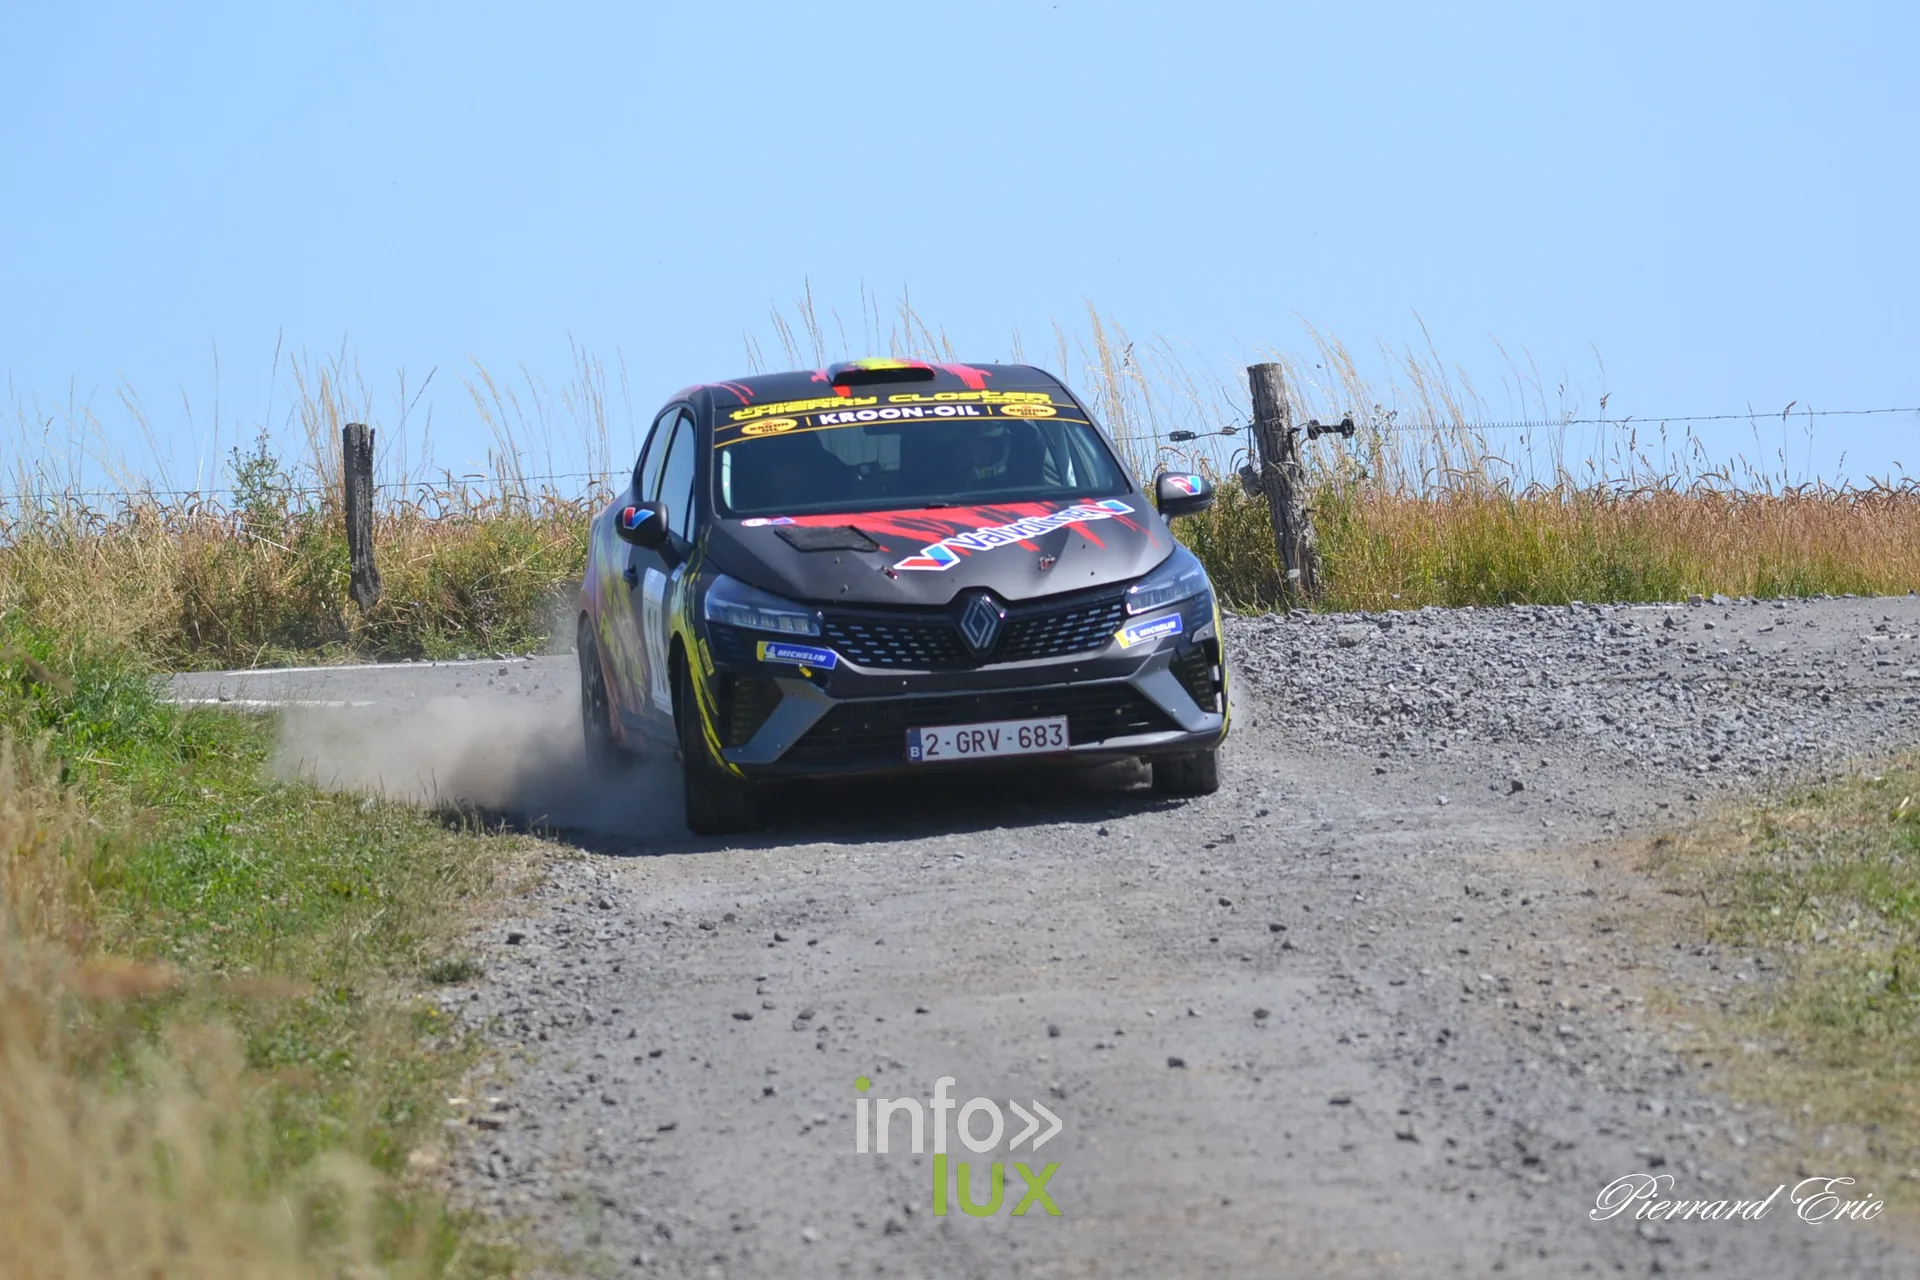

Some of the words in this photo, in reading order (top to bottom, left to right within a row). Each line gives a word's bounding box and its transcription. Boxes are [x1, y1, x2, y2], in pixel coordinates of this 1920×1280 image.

[819, 405, 980, 424] KROON-OIL
[947, 506, 1092, 549] Valvoline
[1139, 621, 1176, 637] MICHELIN
[777, 649, 827, 662] MICHELIN
[910, 747, 920, 757] B
